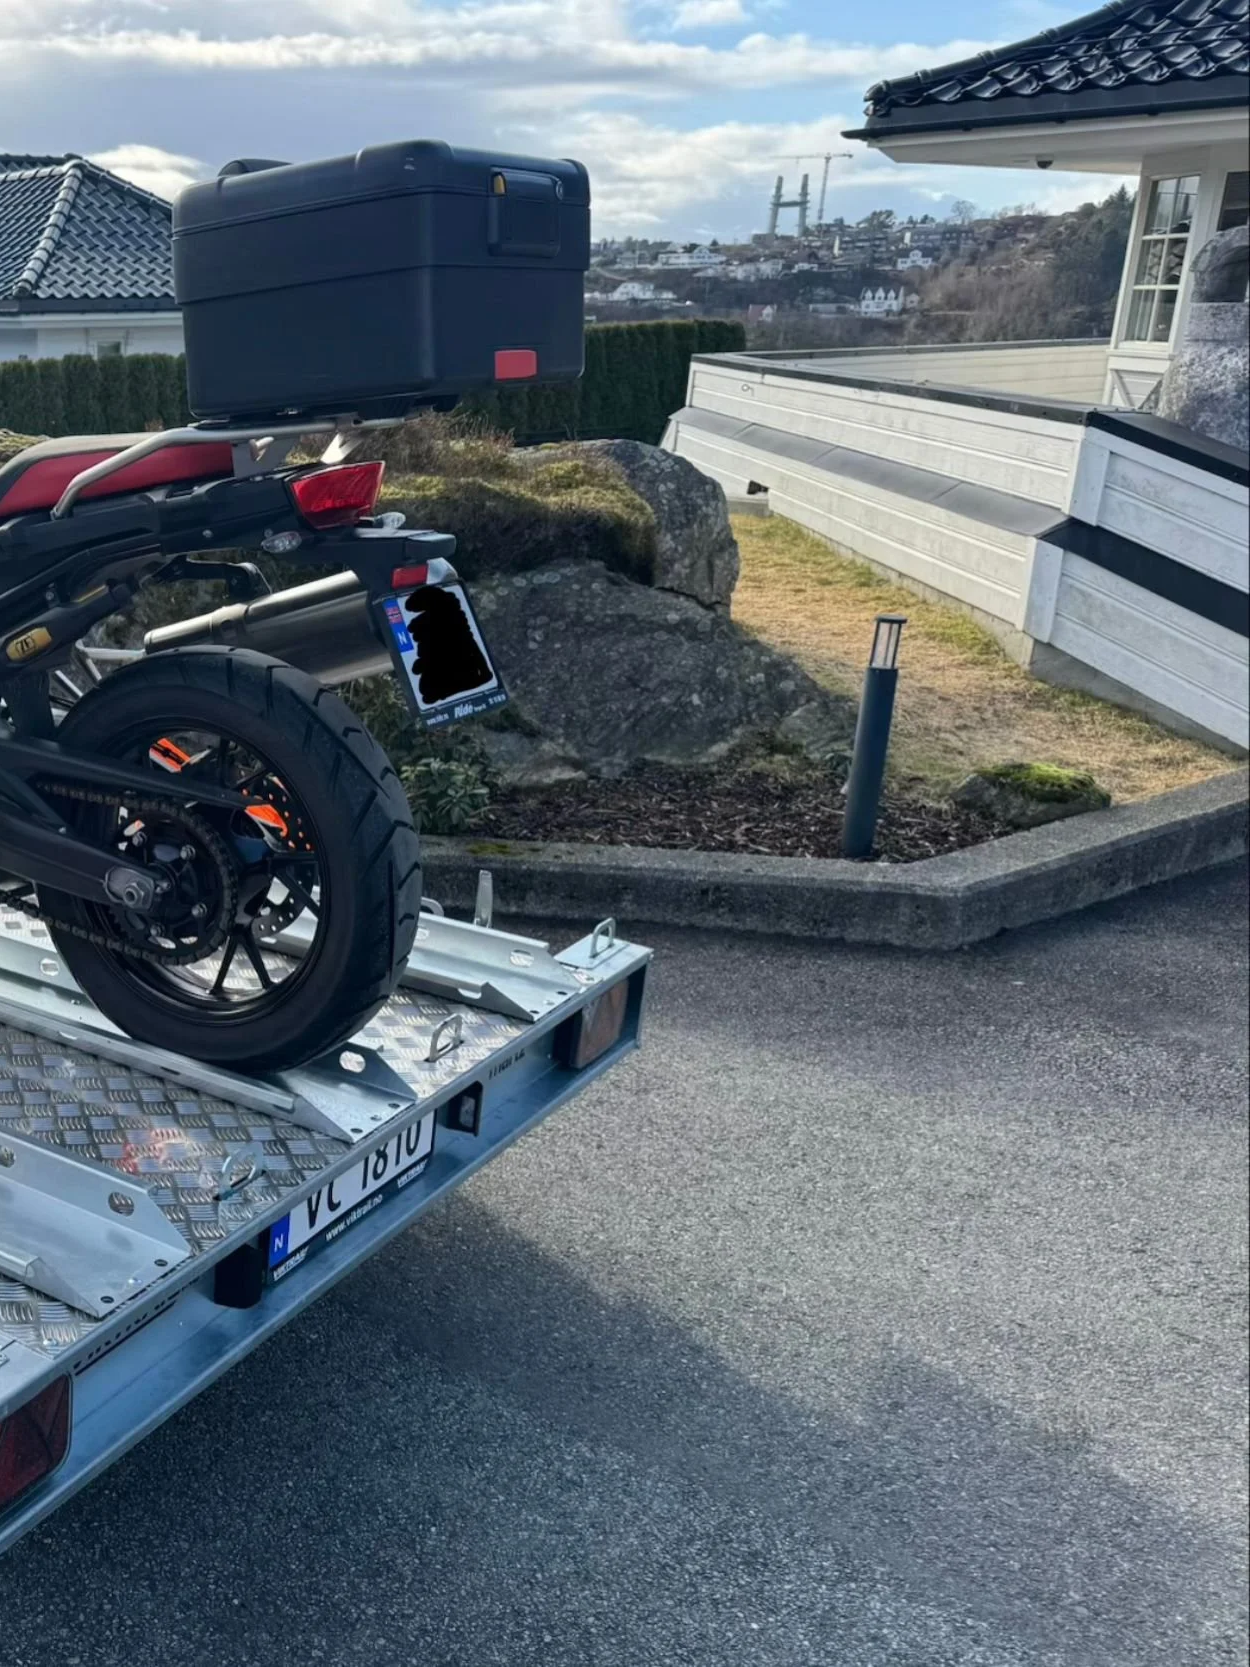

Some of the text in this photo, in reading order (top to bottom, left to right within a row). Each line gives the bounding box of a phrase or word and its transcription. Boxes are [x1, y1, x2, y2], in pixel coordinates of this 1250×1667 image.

[398, 631, 408, 645] N
[307, 1180, 341, 1230] VC
[361, 1119, 422, 1190] 1810
[274, 1234, 284, 1253] N
